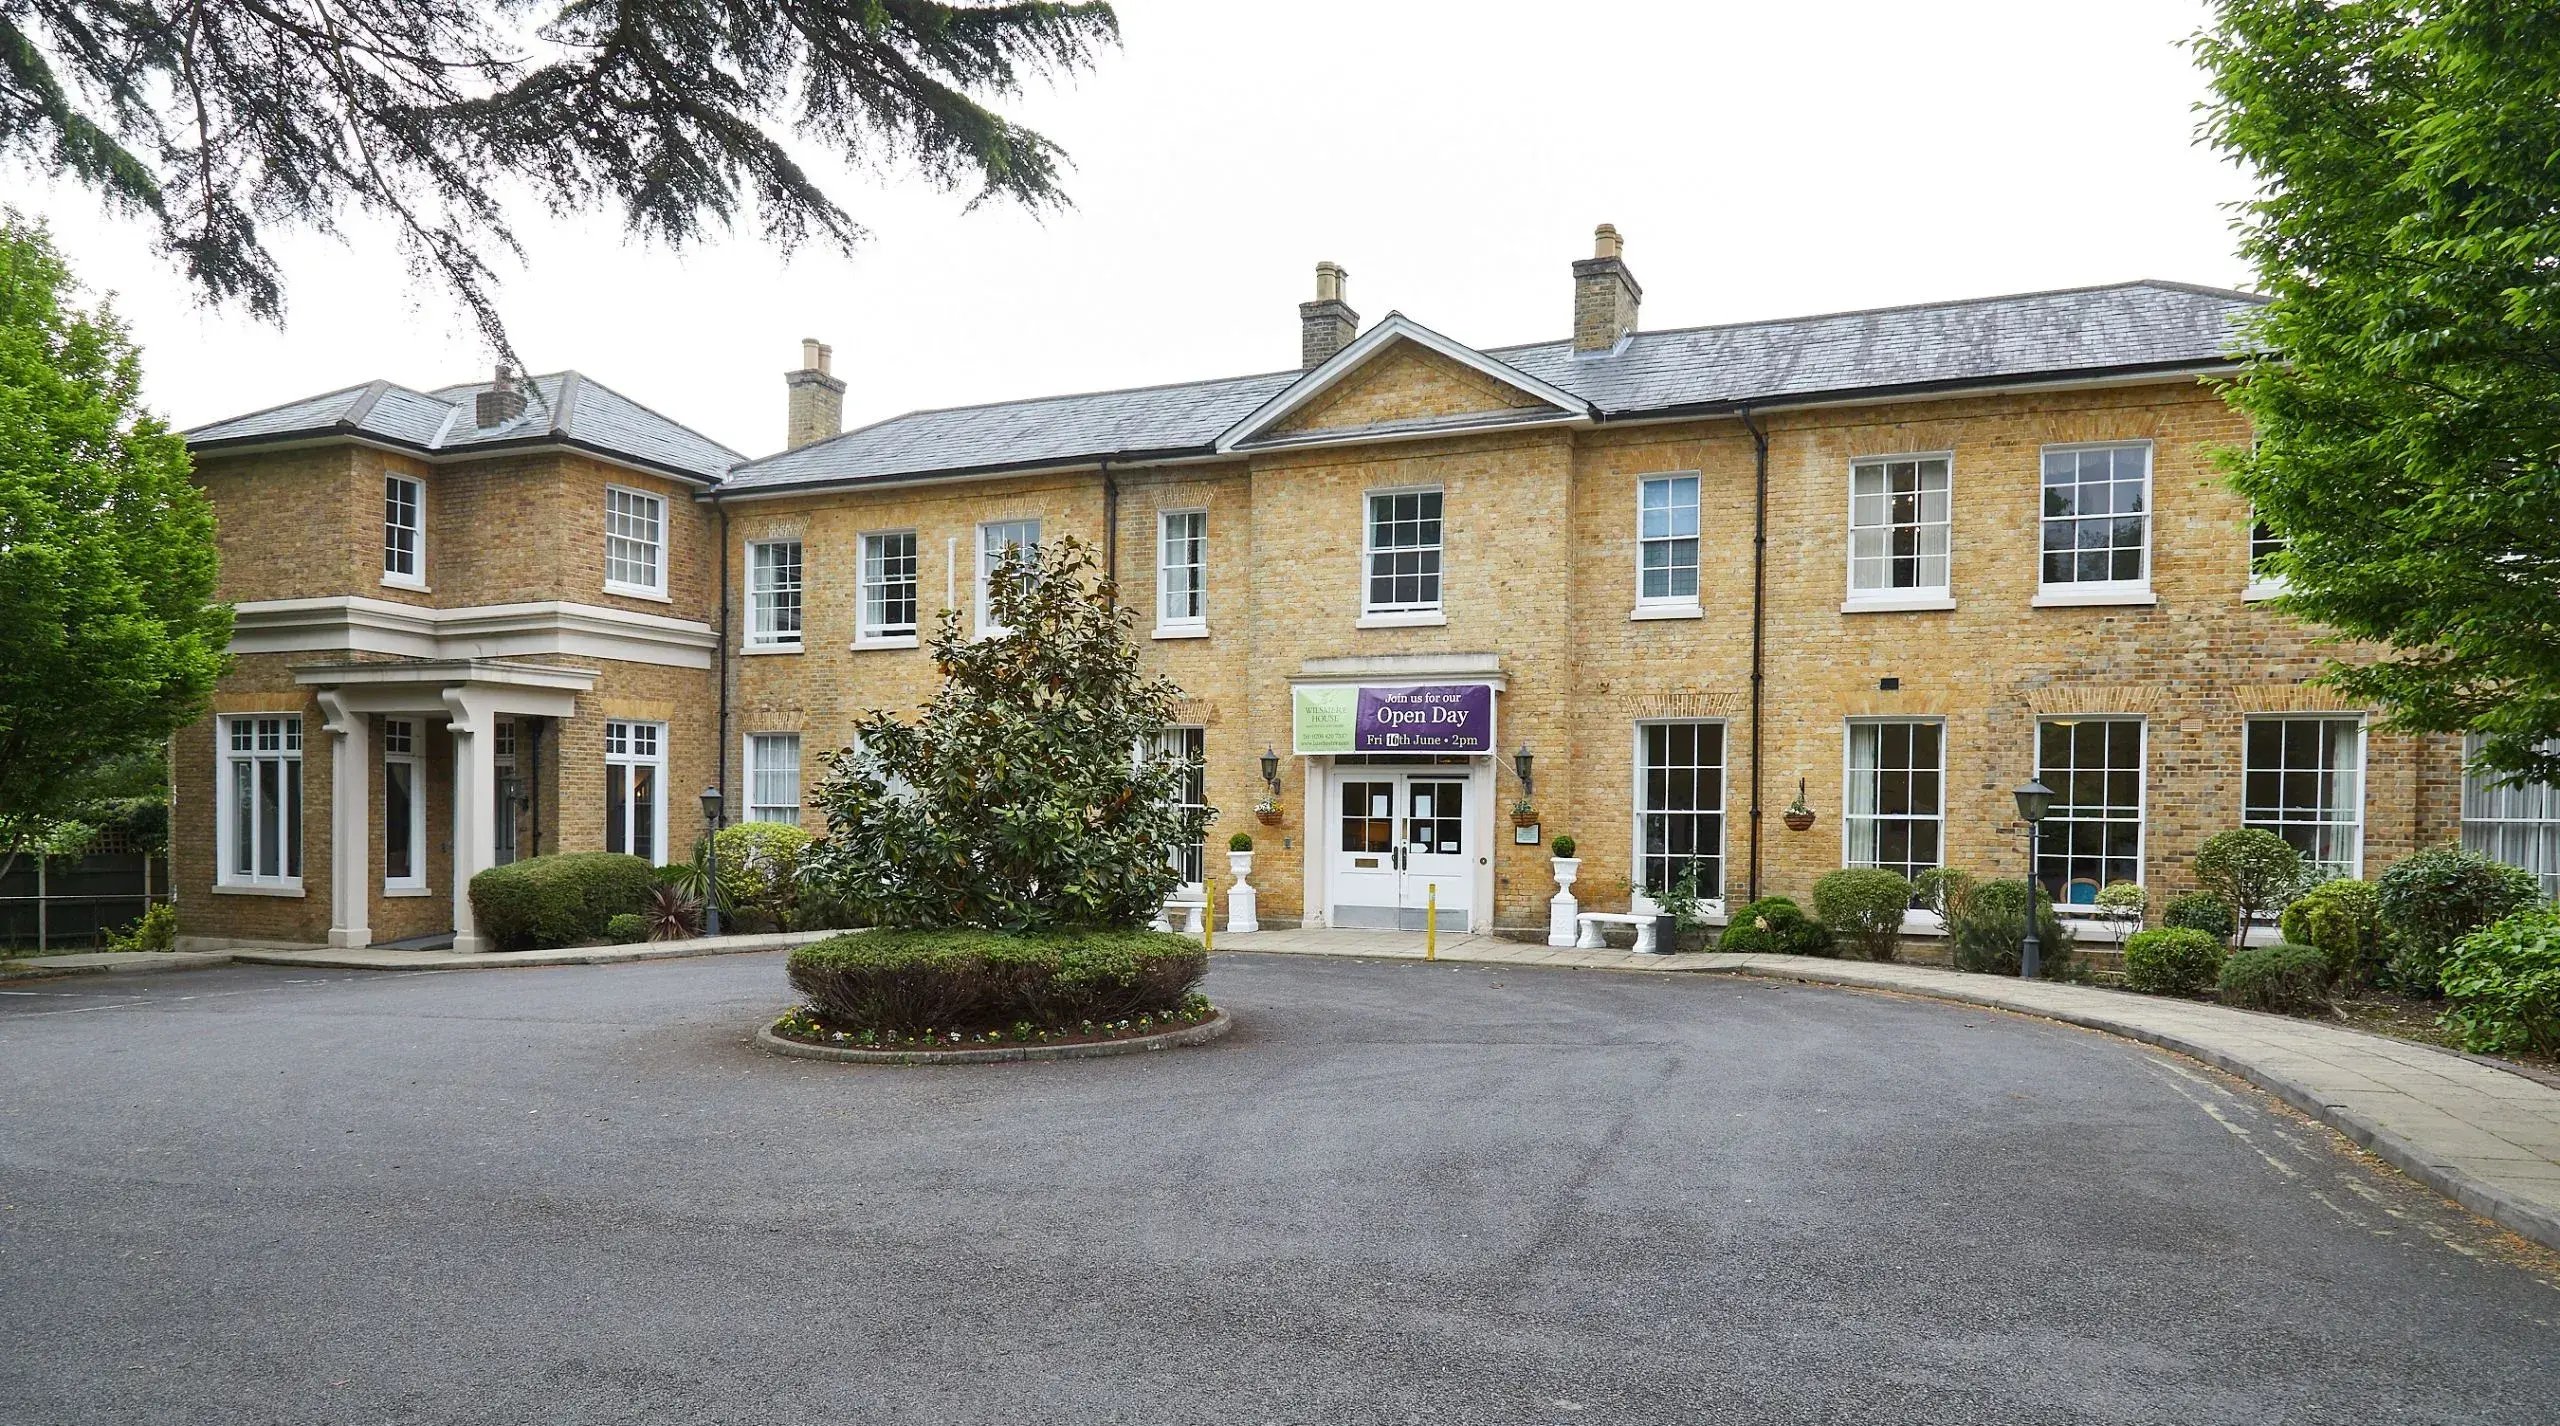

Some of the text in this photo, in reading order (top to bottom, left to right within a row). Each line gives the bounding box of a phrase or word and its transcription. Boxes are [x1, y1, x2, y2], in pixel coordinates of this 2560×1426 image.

[1385, 692, 1461, 703] Join us for our
[1377, 706, 1469, 727] Open Day
[1367, 734, 1382, 745] Fri
[1413, 734, 1441, 745] June
[1452, 734, 1478, 747] 2pm
